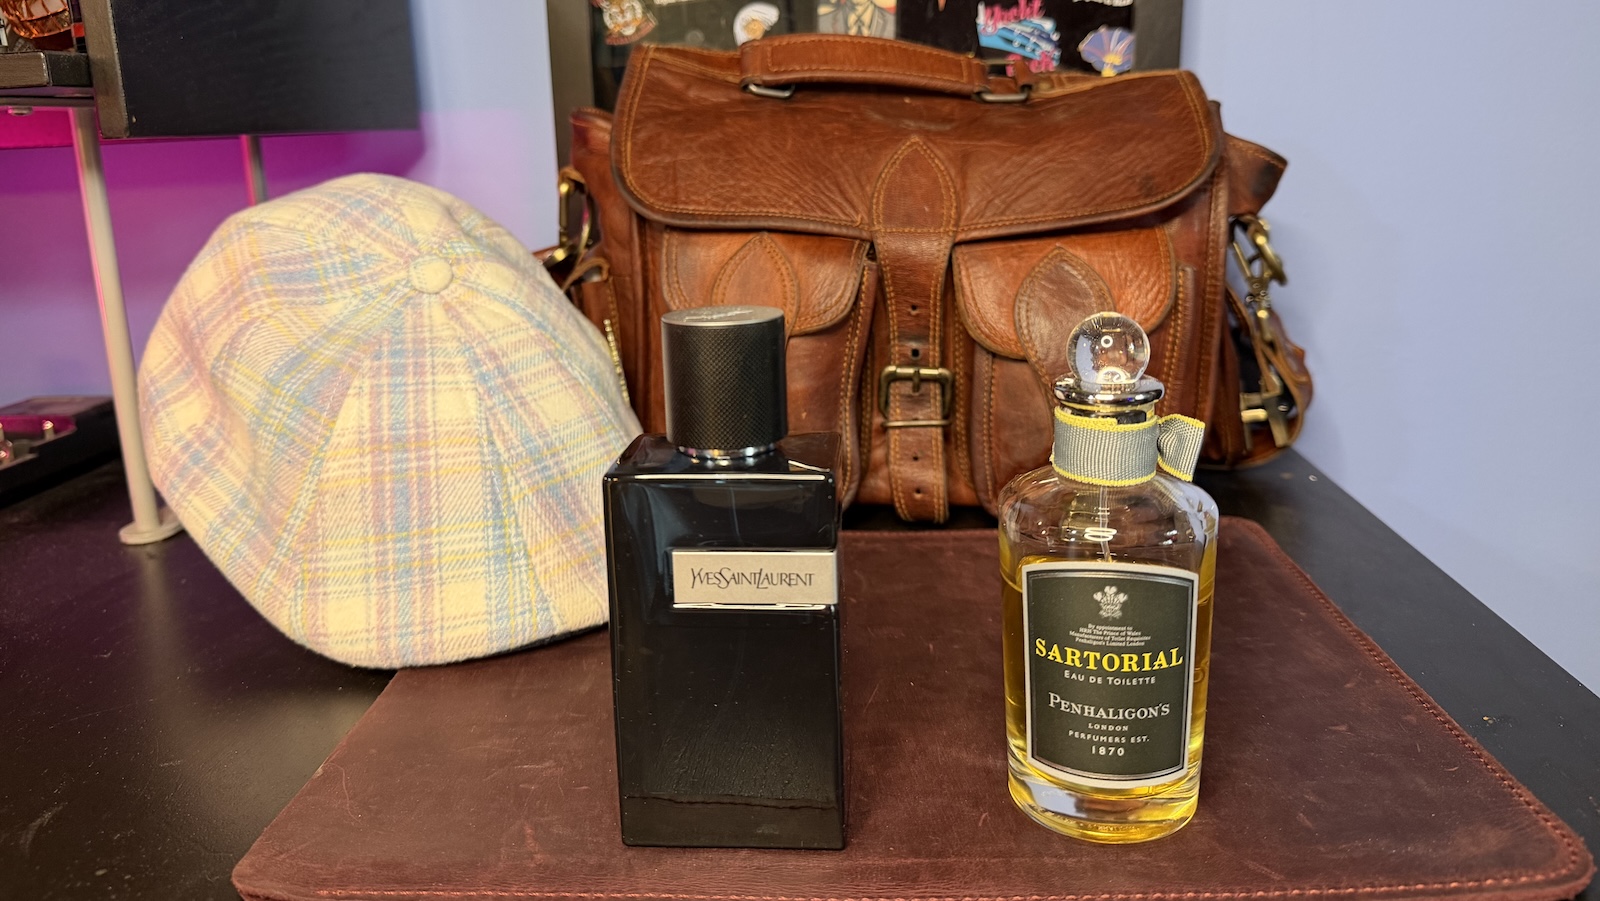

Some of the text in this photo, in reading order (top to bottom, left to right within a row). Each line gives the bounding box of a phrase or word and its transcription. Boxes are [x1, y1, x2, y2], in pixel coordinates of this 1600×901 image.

[1035, 638, 1184, 673] SARTORIAL
[1064, 669, 1156, 686] EAU DE TOILETTE
[1048, 692, 1170, 720] PENHALIGON'S
[1088, 722, 1129, 732] LONDON
[1068, 730, 1150, 744] PERFUMERS EST.
[1091, 745, 1125, 757] 1870
